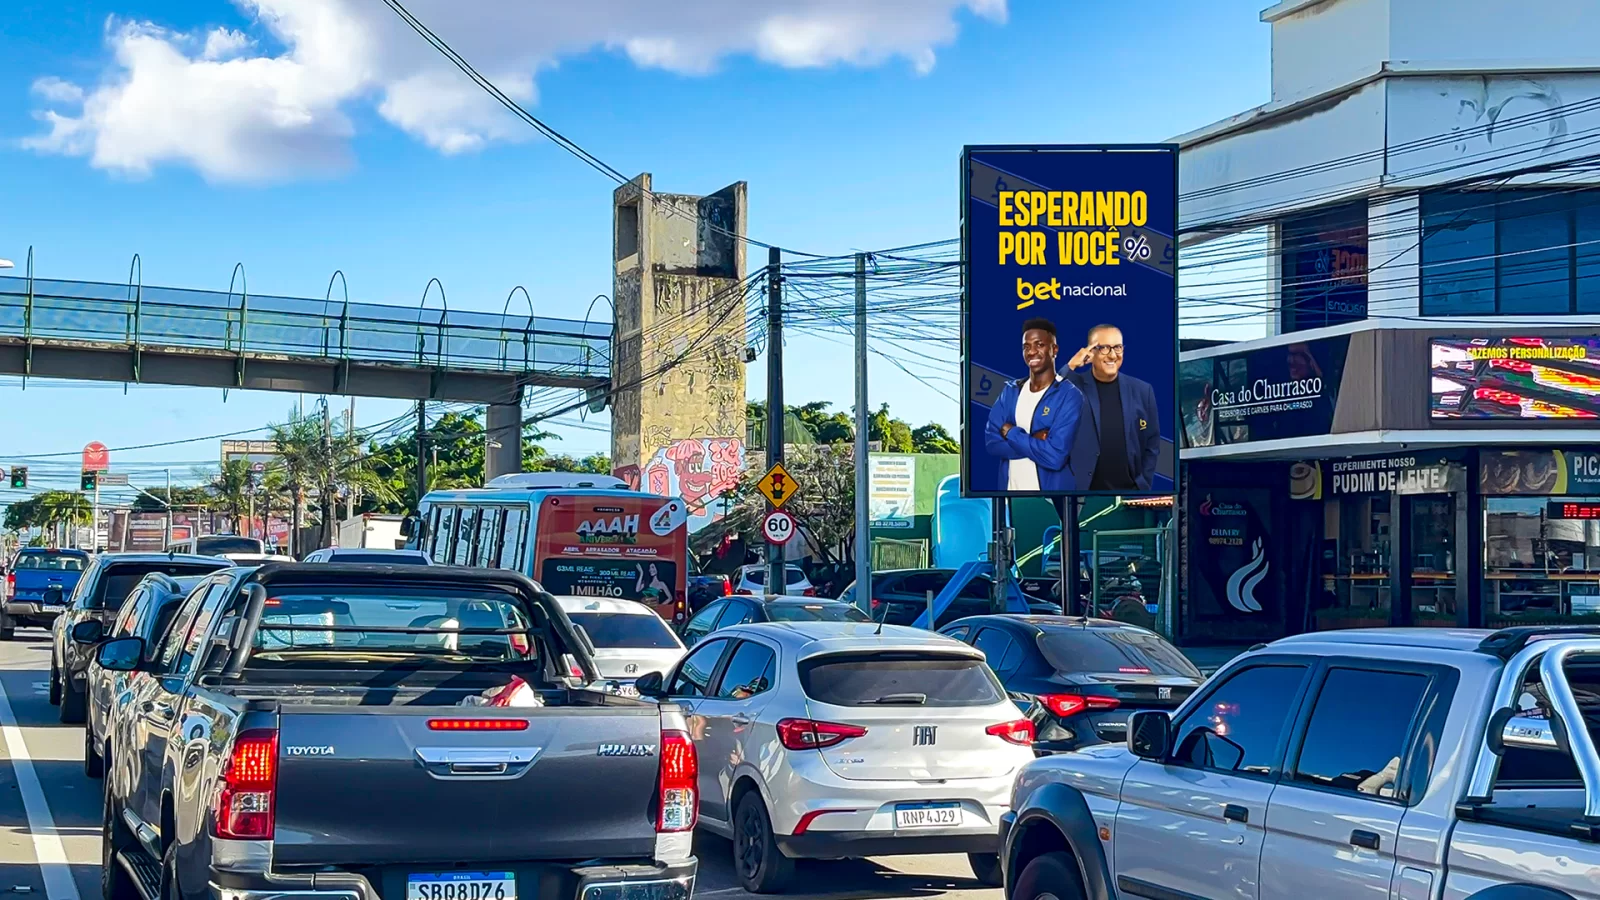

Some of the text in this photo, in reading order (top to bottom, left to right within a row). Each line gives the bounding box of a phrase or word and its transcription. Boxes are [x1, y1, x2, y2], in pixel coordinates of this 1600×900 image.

[998, 190, 1148, 227] ESPERANDO
[998, 231, 1047, 266] POR
[1059, 226, 1121, 266] VOCÊ
[1016, 277, 1127, 309] bet nacional
[1510, 345, 1586, 362] PERSONALIZAÇÃO
[1211, 377, 1322, 406] Casa do Churrasco
[1333, 457, 1416, 472] EXPERIMENTE NOSSO
[1574, 456, 1600, 476] PIC
[1333, 468, 1440, 494] PUDIM DE LEITE
[576, 514, 640, 533] AAAH
[767, 518, 790, 532] 60
[570, 584, 623, 597] 1 MILHÃO
[912, 725, 938, 746] FIAT
[286, 745, 335, 755] TOYOTA
[597, 743, 656, 757] HILUX
[902, 810, 955, 824] RNP4J29
